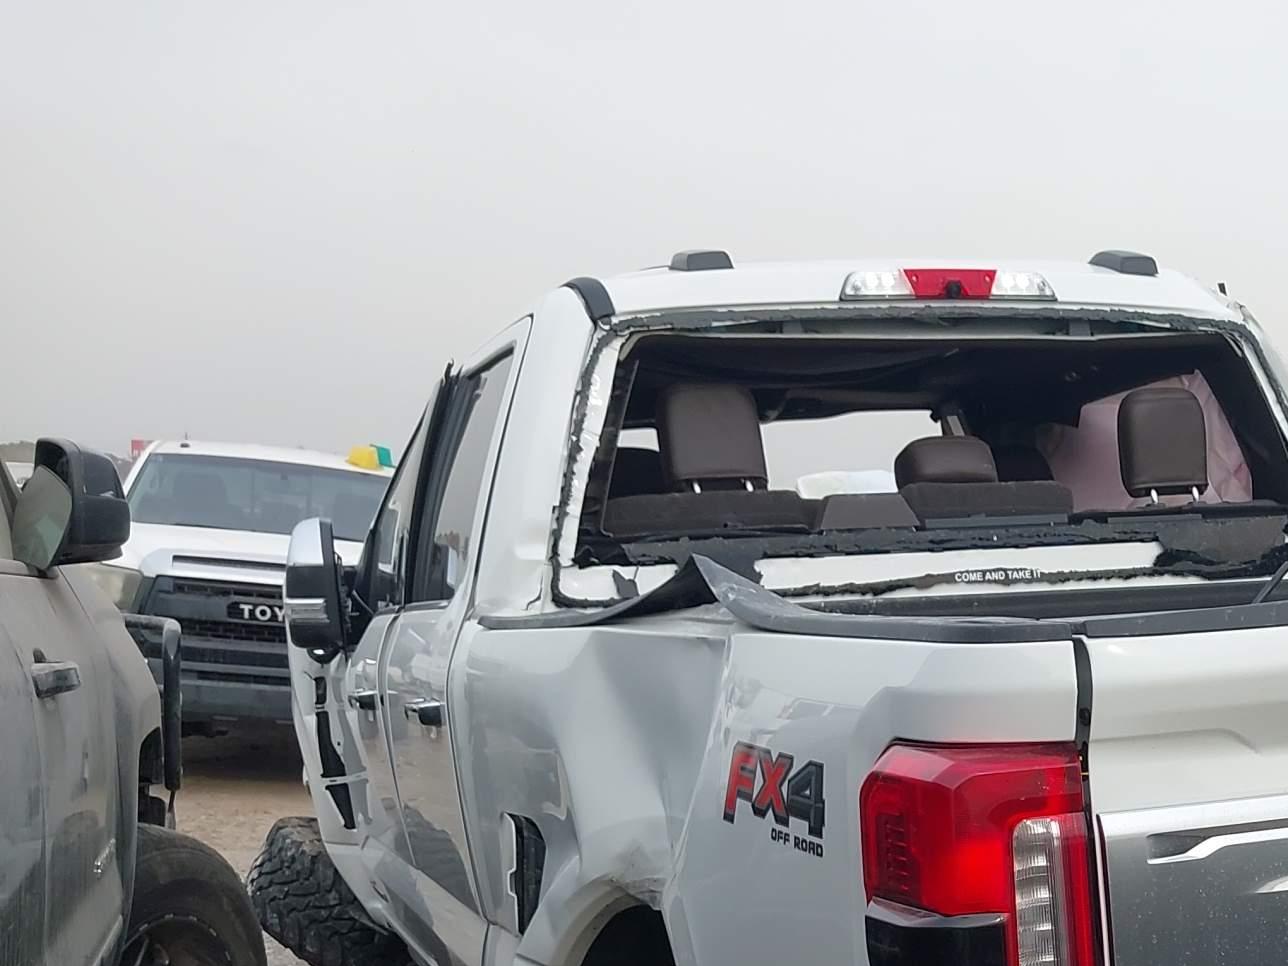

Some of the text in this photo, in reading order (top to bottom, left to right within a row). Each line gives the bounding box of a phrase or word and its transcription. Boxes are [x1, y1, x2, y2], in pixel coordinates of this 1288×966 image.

[954, 572, 984, 582] COME
[984, 570, 1006, 581] AND
[1007, 569, 1032, 580] TAKE
[722, 740, 826, 840] FX4
[770, 827, 825, 858] OFF ROAD
